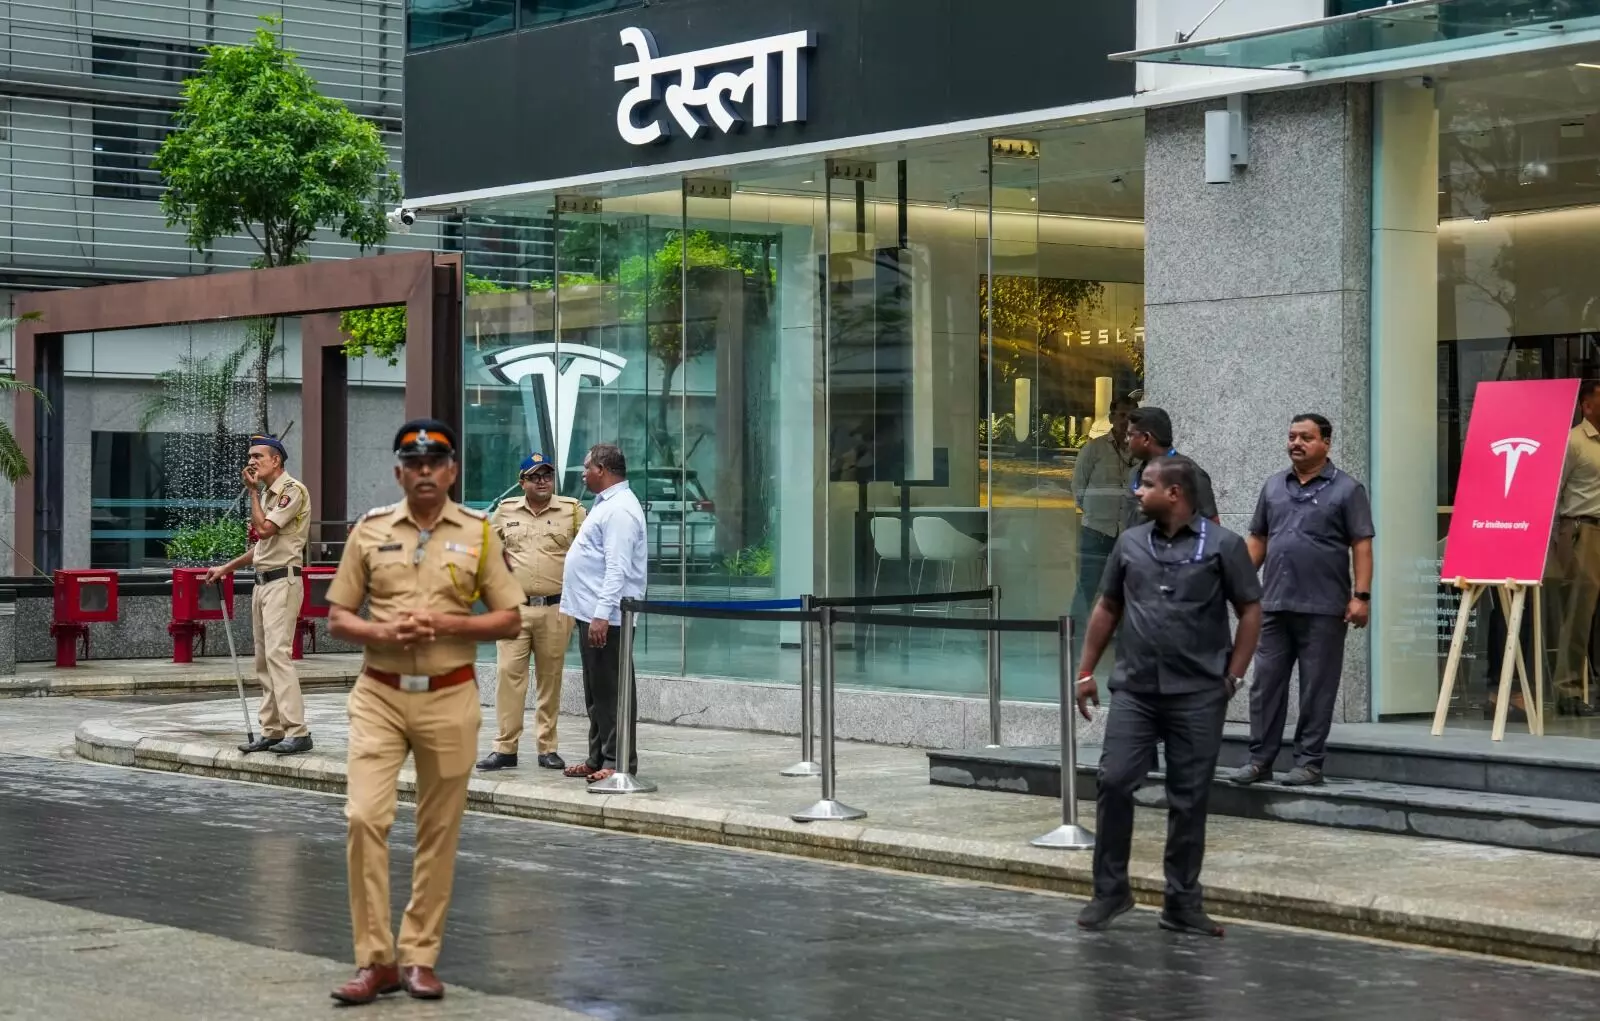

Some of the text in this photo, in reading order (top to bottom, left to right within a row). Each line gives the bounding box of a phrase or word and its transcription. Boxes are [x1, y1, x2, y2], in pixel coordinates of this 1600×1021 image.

[614, 26, 809, 145] टेस्ला
[1063, 326, 1145, 347] TESLA
[1472, 519, 1530, 531] For invitees only
